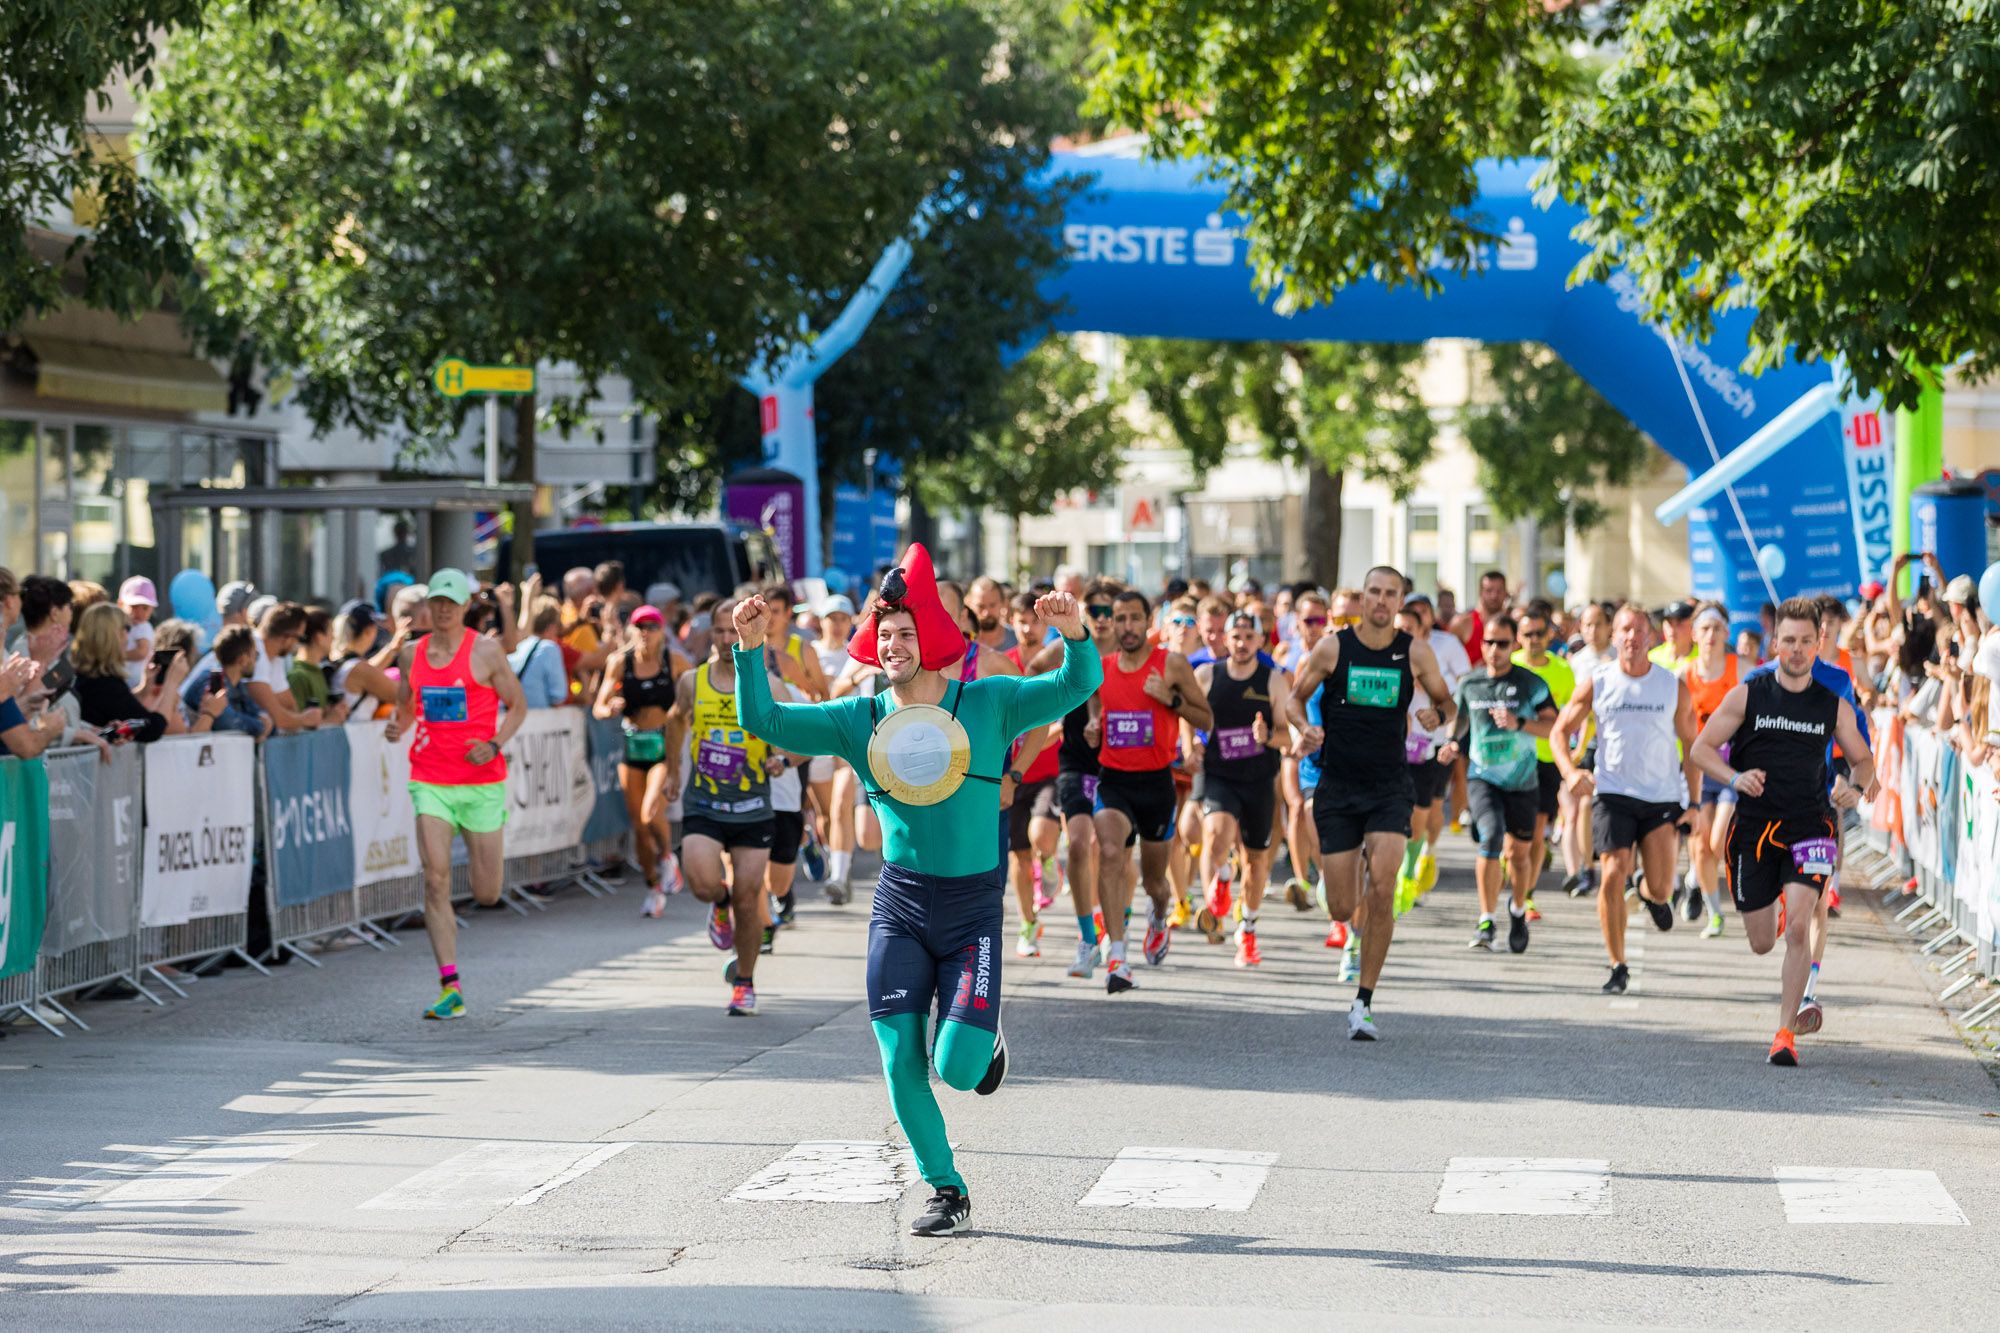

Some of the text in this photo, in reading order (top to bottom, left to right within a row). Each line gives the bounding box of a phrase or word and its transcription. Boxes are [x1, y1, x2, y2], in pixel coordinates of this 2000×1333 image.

[1064, 224, 1188, 264] ERSTE
[445, 367, 464, 389] H
[1754, 714, 1825, 735] joinfitness.at
[974, 936, 991, 999] SPARKASSE
[881, 993, 901, 1001] JAKO
